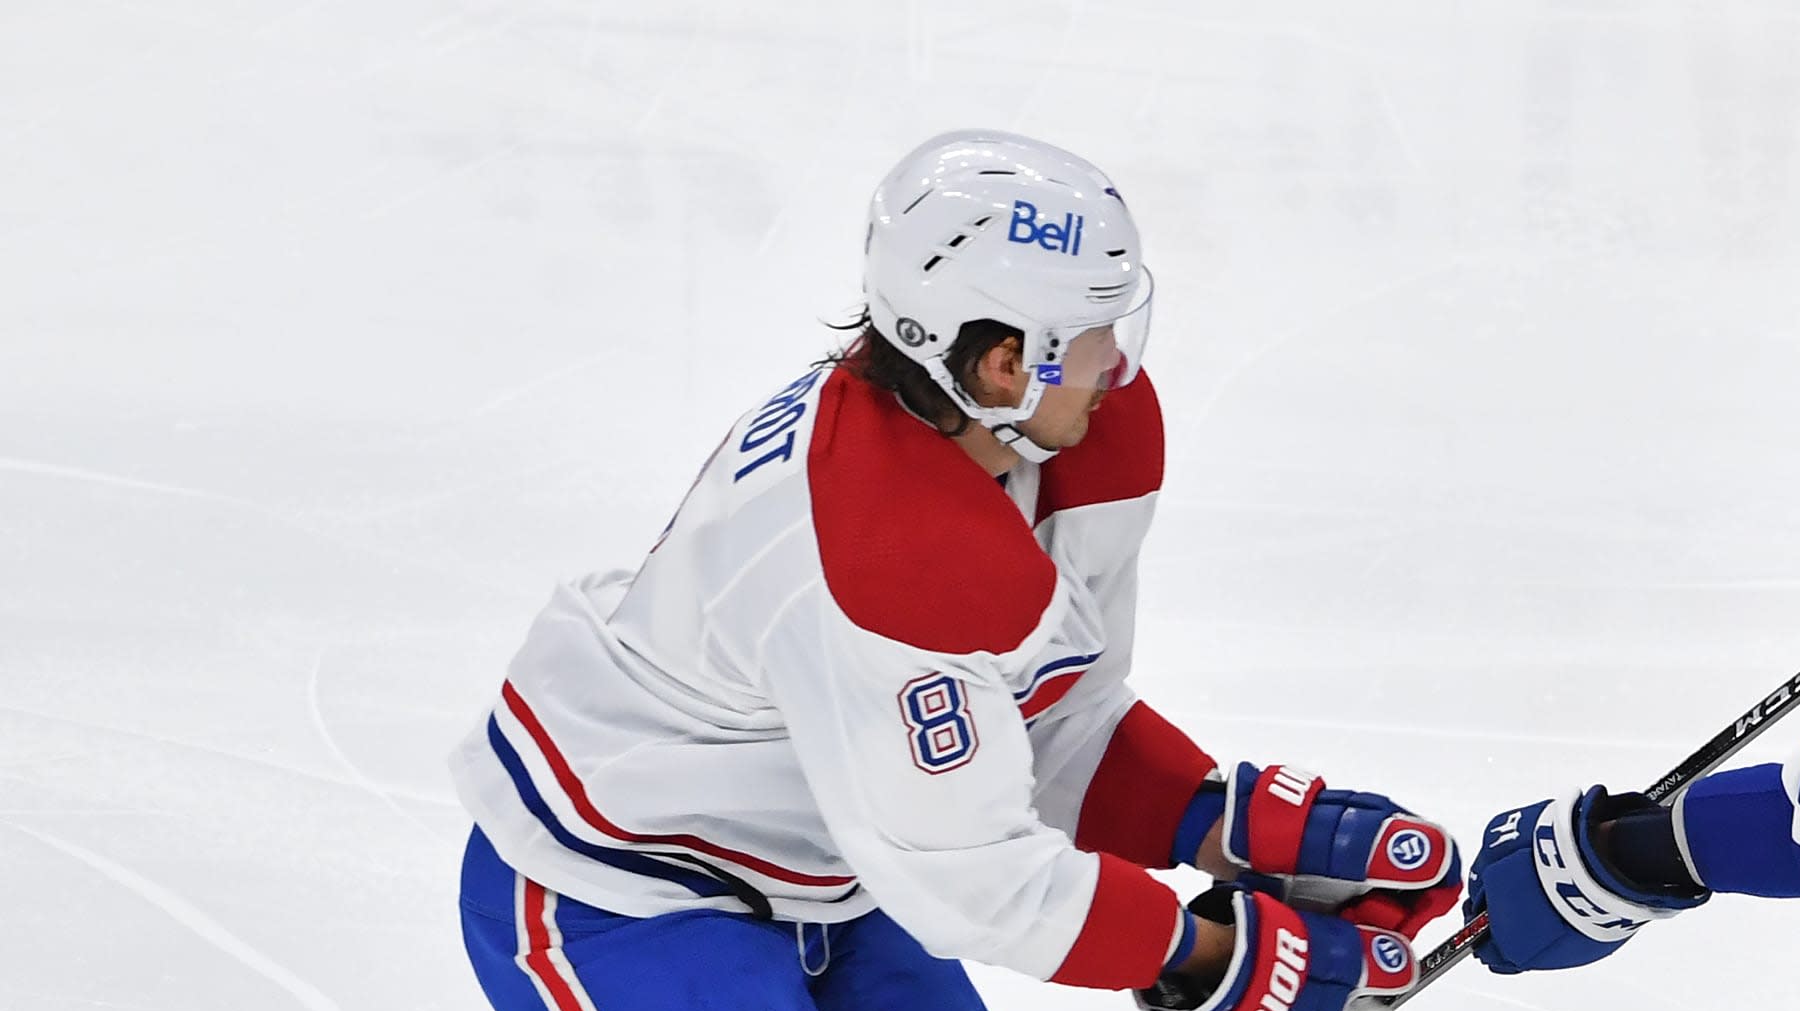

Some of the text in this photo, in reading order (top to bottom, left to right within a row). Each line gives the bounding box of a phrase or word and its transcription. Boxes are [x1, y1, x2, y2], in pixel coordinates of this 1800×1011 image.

[1007, 199, 1084, 256] Bell
[897, 670, 980, 775] 8
[1489, 811, 1522, 848] 91
